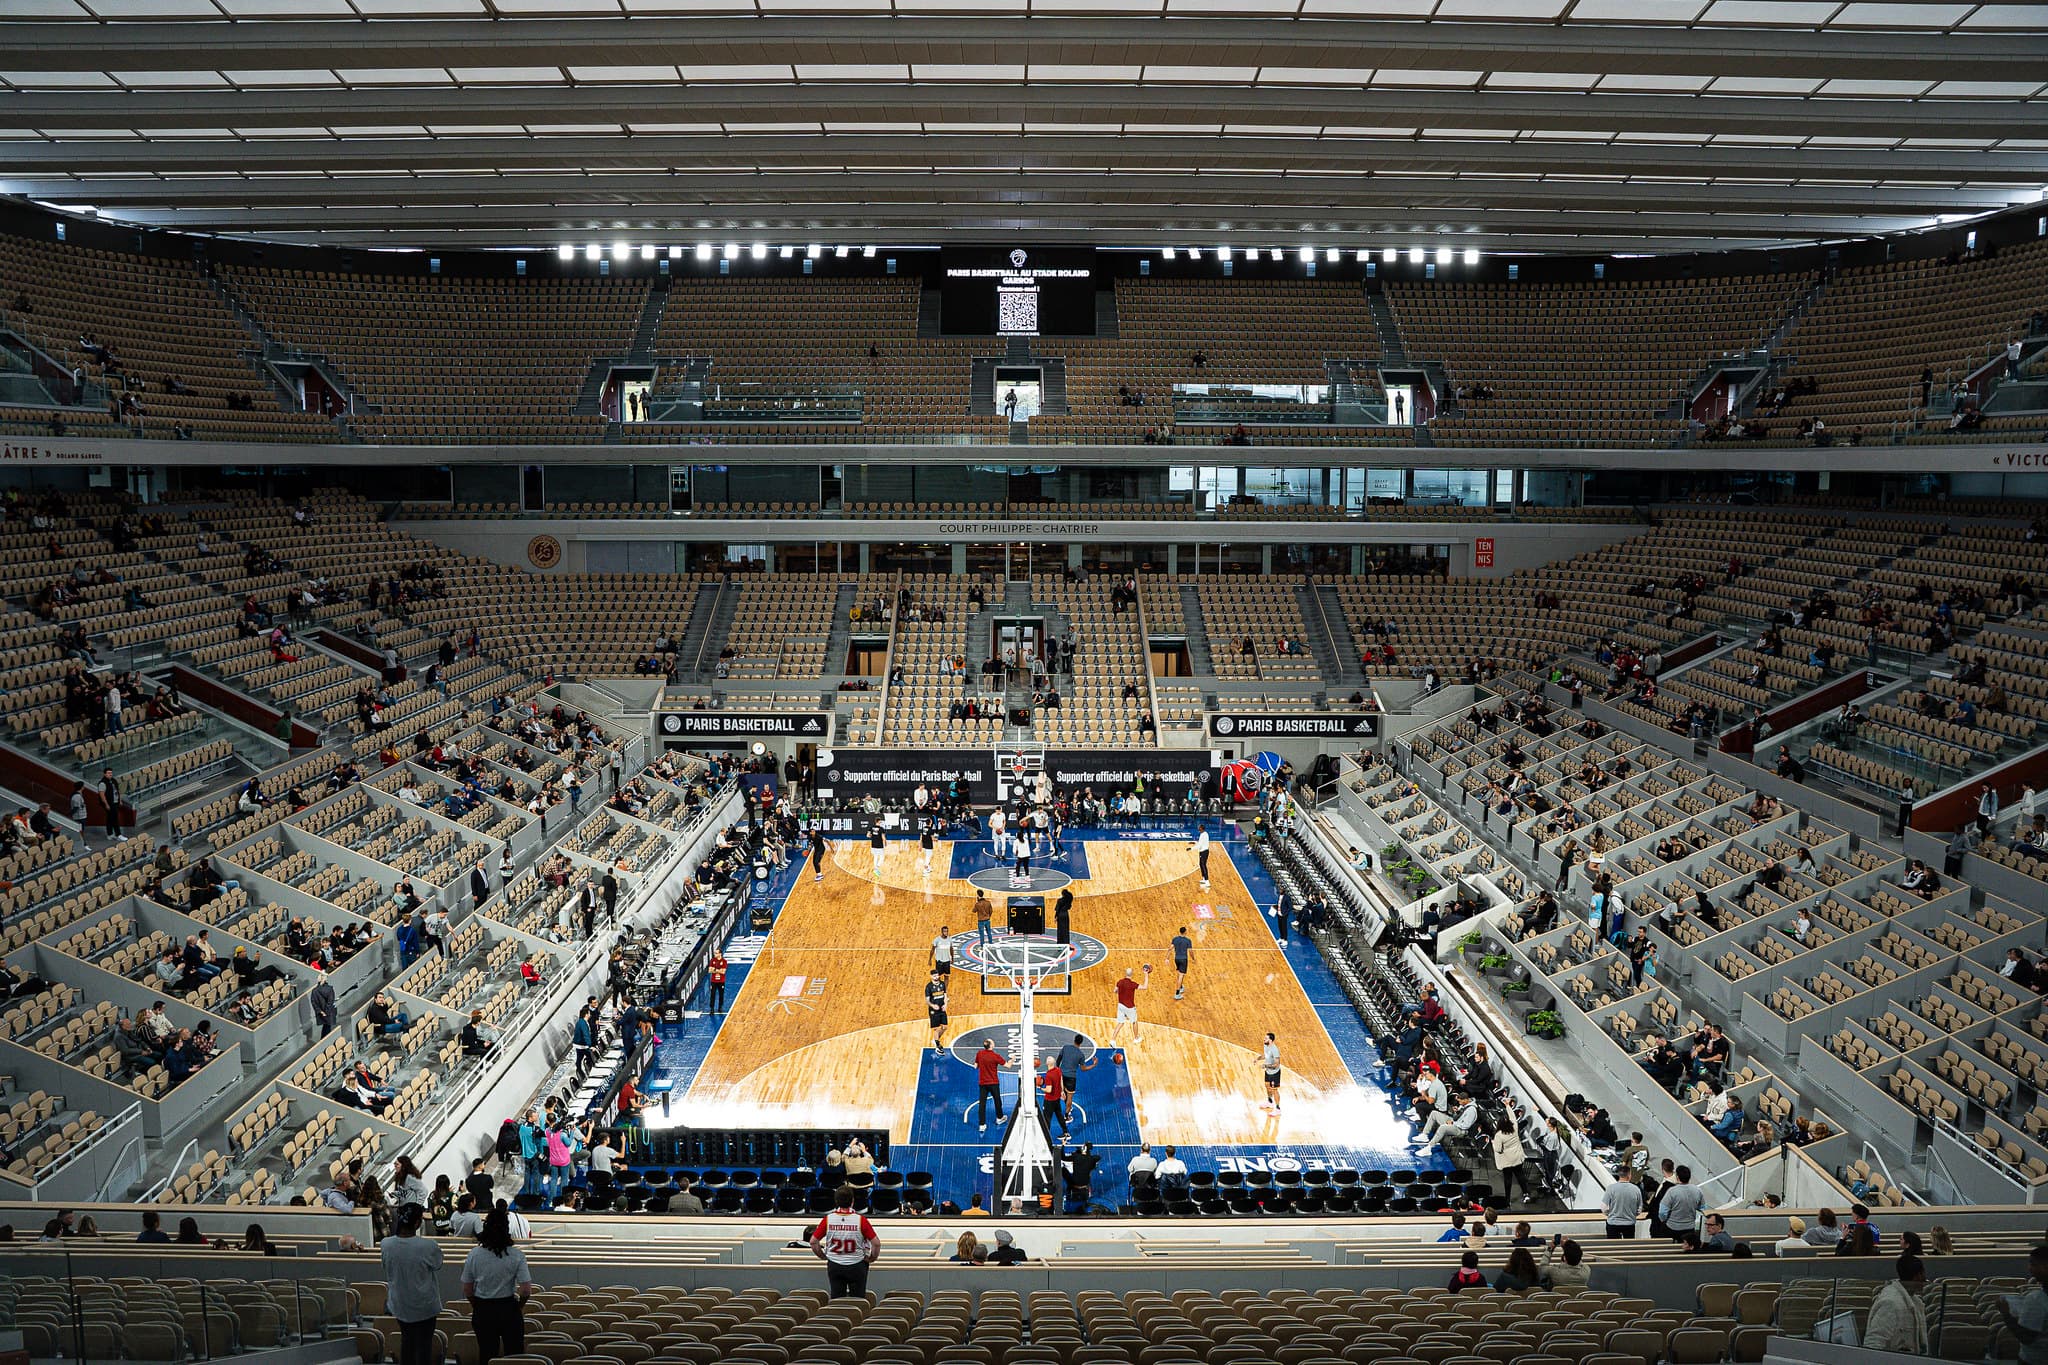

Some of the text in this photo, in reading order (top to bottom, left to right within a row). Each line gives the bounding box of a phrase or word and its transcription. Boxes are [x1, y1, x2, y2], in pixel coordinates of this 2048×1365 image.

[947, 269, 1090, 277] PARIS BASKETBALL AU STADE ROLAND
[939, 524, 978, 533] COURT
[981, 524, 1032, 533] PHILIPPE
[1042, 524, 1098, 534] CHATRIER
[1478, 541, 1491, 550] TEN
[1478, 555, 1491, 564] NIS
[685, 718, 795, 731] PARIS BASKETBALL
[1238, 719, 1347, 732] PARIS BASKETBALL
[844, 770, 982, 784] Supporter officiel du Paris Basktball
[1056, 770, 1095, 784] Supporter
[1096, 770, 1122, 783] officiel
[1124, 770, 1133, 782] du
[1216, 1156, 1356, 1173] THE ONE
[831, 1239, 857, 1253] 20
